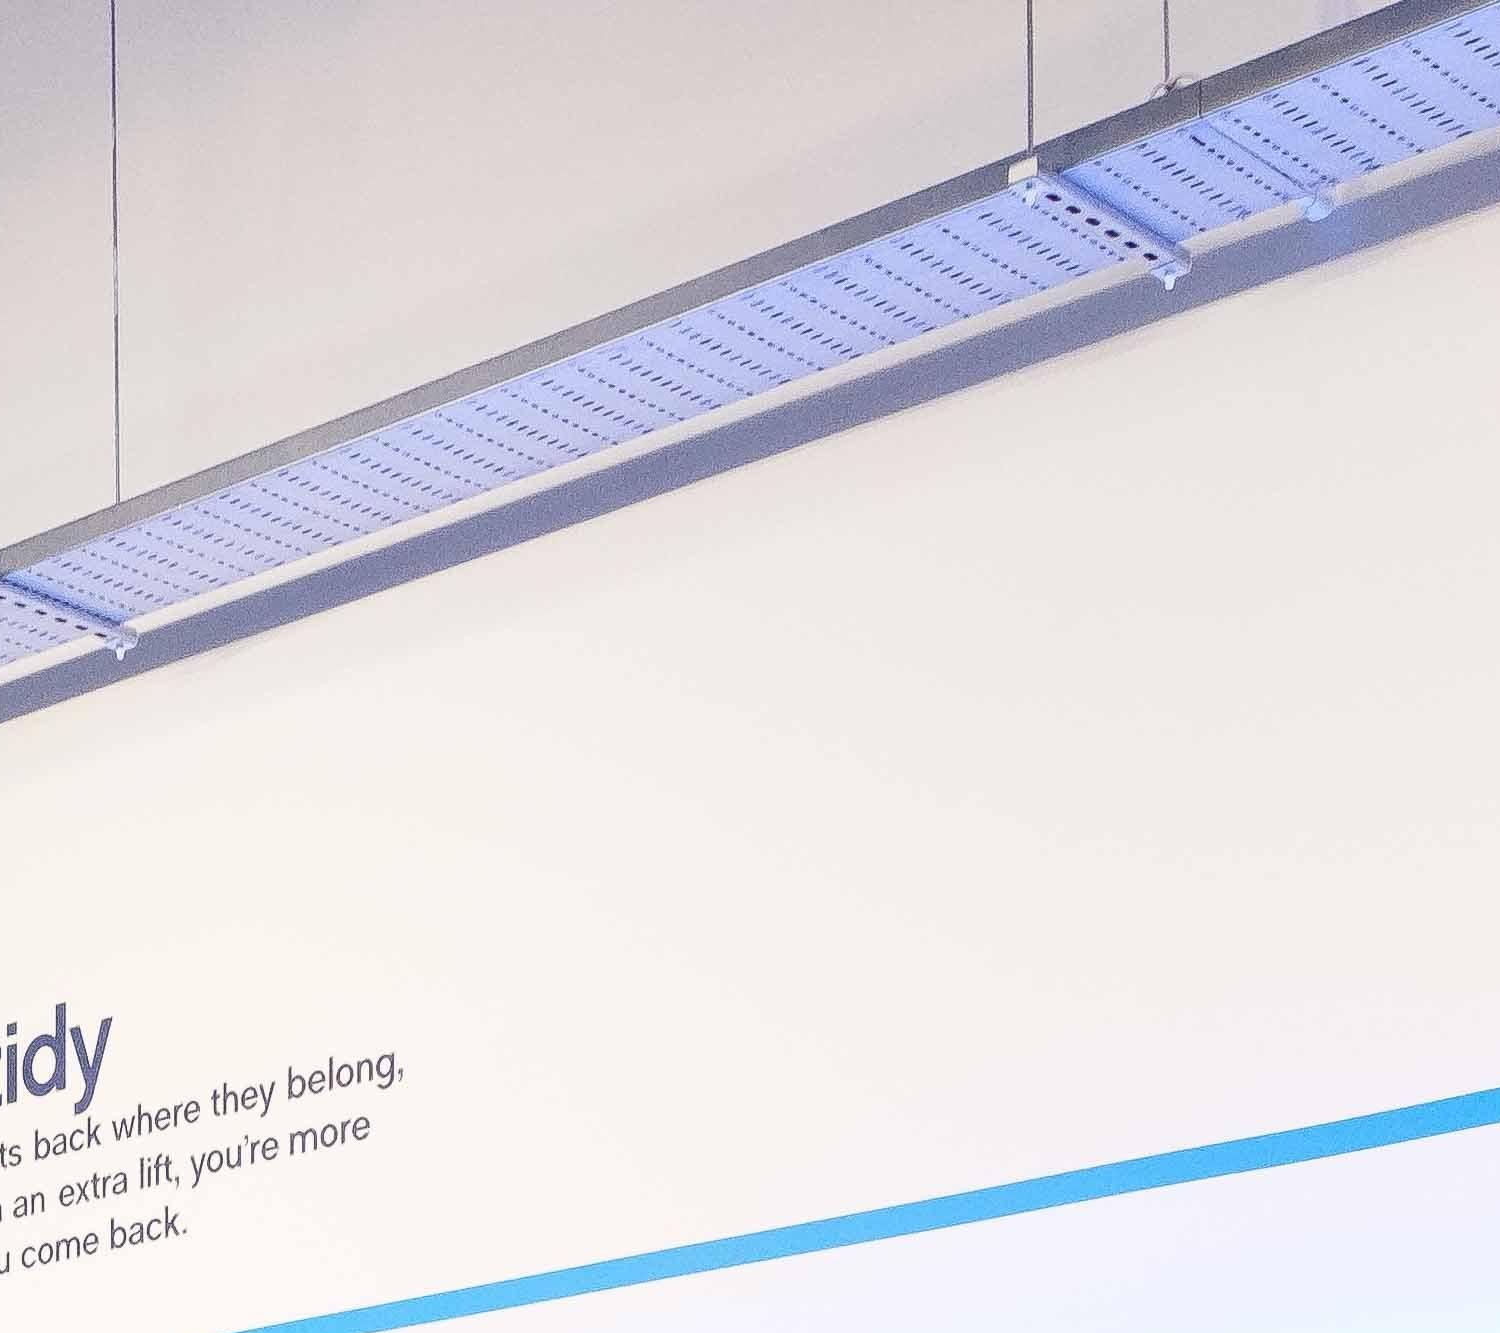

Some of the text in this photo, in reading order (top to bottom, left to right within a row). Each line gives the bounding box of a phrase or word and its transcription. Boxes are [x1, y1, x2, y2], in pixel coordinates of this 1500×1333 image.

[35, 1116, 101, 1160] back
[112, 1101, 200, 1141] where
[211, 1081, 275, 1118] they
[288, 1052, 403, 1100] belong,
[13, 1192, 45, 1218] an
[59, 1172, 127, 1207] extra
[140, 1153, 179, 1189] lift,
[191, 1135, 279, 1189] you're
[290, 1117, 370, 1155] more
[22, 1233, 99, 1268] come
[111, 1206, 187, 1250] back.
